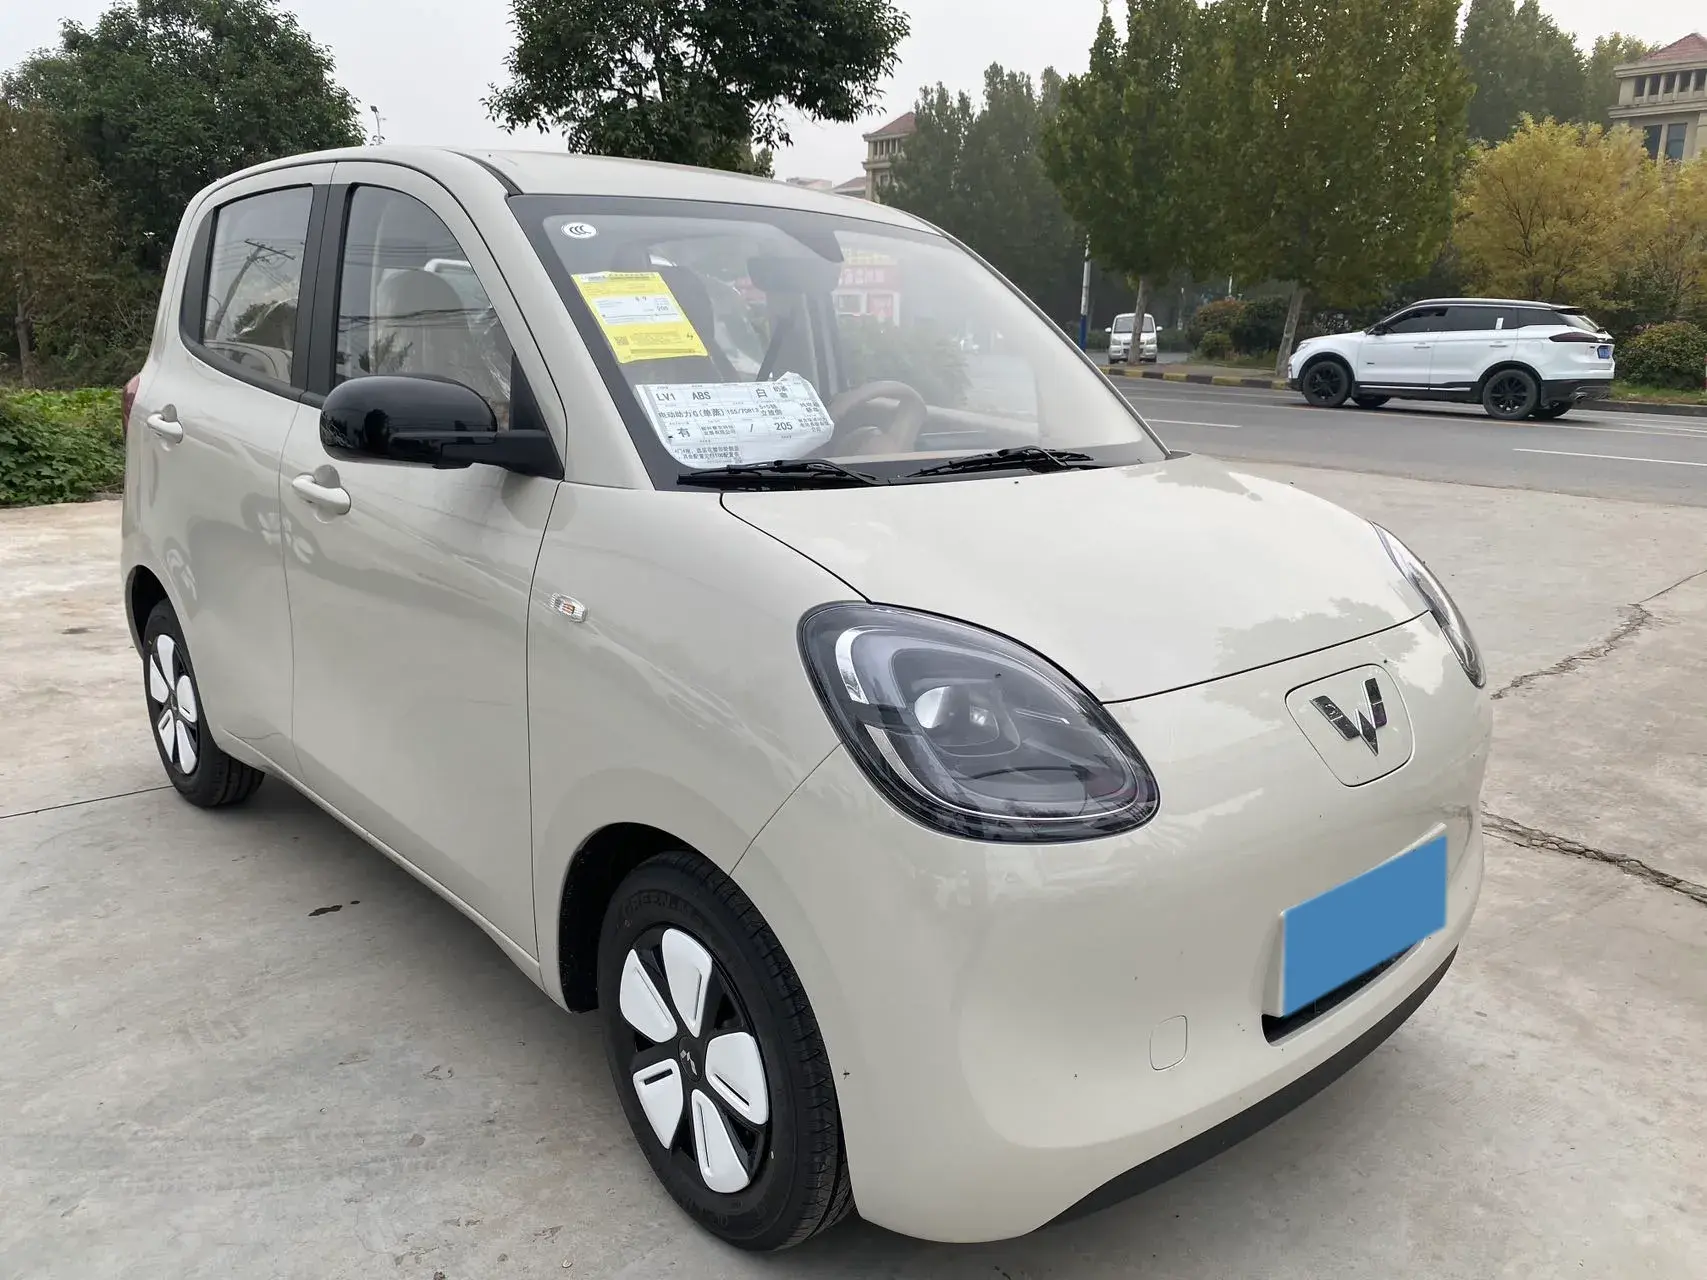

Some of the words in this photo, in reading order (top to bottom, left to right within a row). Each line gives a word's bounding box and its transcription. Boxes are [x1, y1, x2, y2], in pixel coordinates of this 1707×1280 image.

[692, 391, 711, 400] ABS
[756, 388, 768, 398] 白
[774, 422, 793, 431] 205
[677, 427, 691, 438] 有
